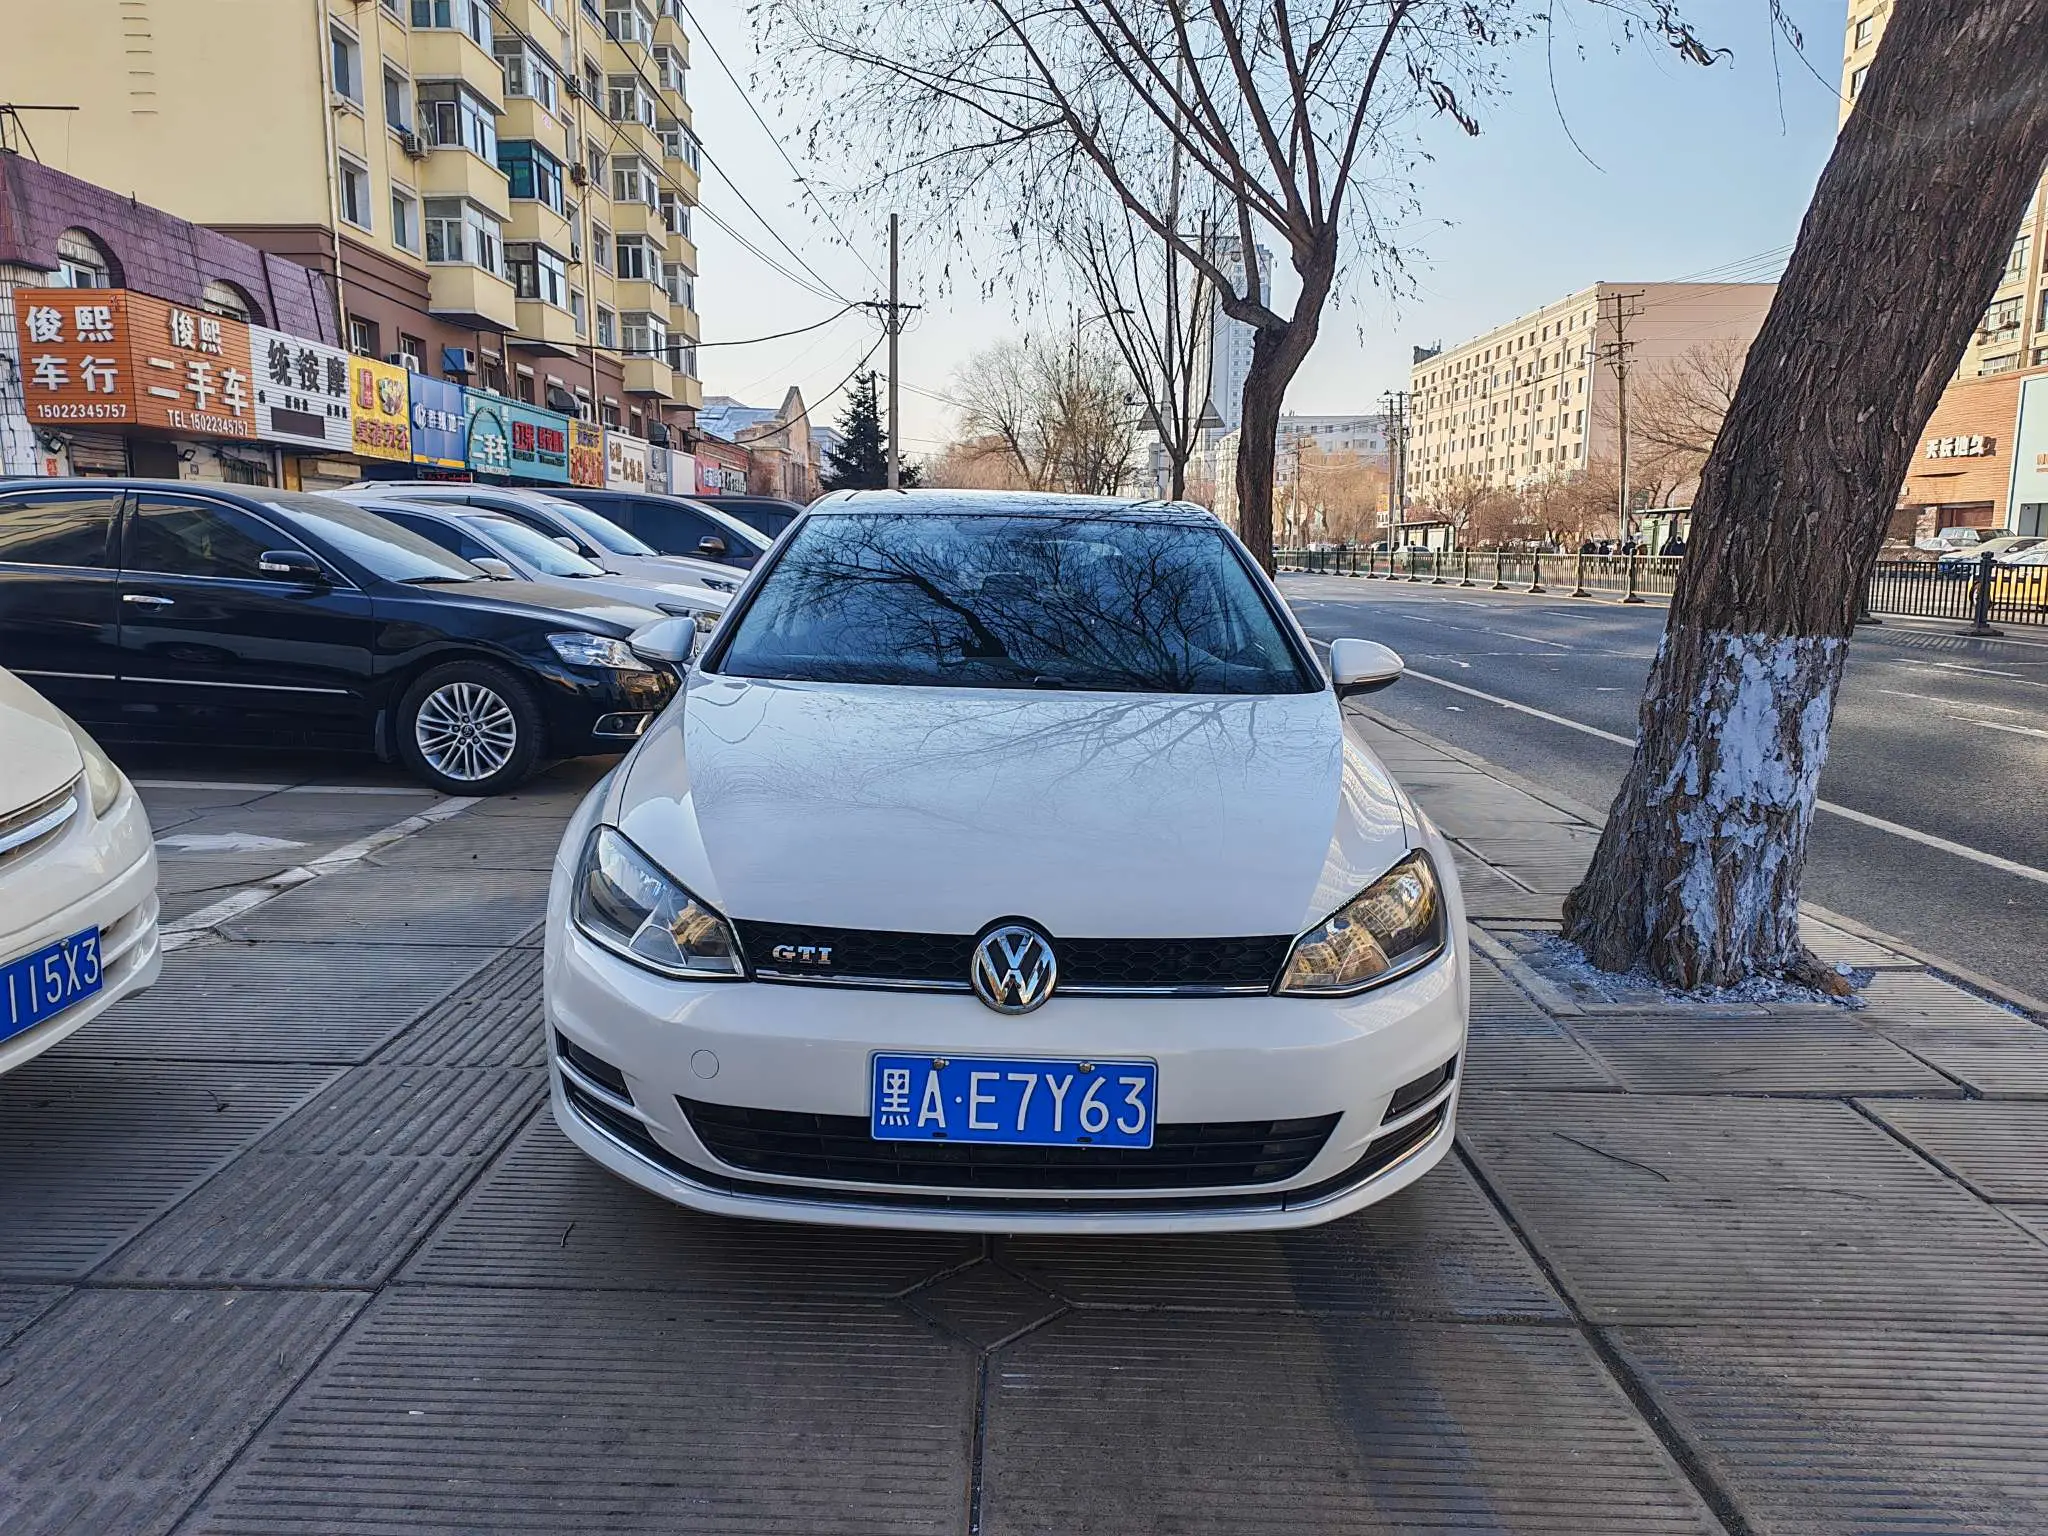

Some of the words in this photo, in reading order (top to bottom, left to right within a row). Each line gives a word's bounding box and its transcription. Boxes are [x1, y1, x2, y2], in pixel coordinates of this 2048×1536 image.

[25, 305, 114, 343] 俊熙
[168, 308, 223, 355] 俊熙
[31, 354, 118, 393] 车行
[148, 357, 249, 417] 二手车
[38, 404, 126, 418] 15022345757
[167, 409, 186, 428] TEL
[190, 413, 248, 437] 15022345757
[472, 432, 507, 466] 二手车
[1926, 434, 1984, 459] 天长地久
[772, 944, 832, 966] GTI
[9, 937, 99, 1024] 115X3
